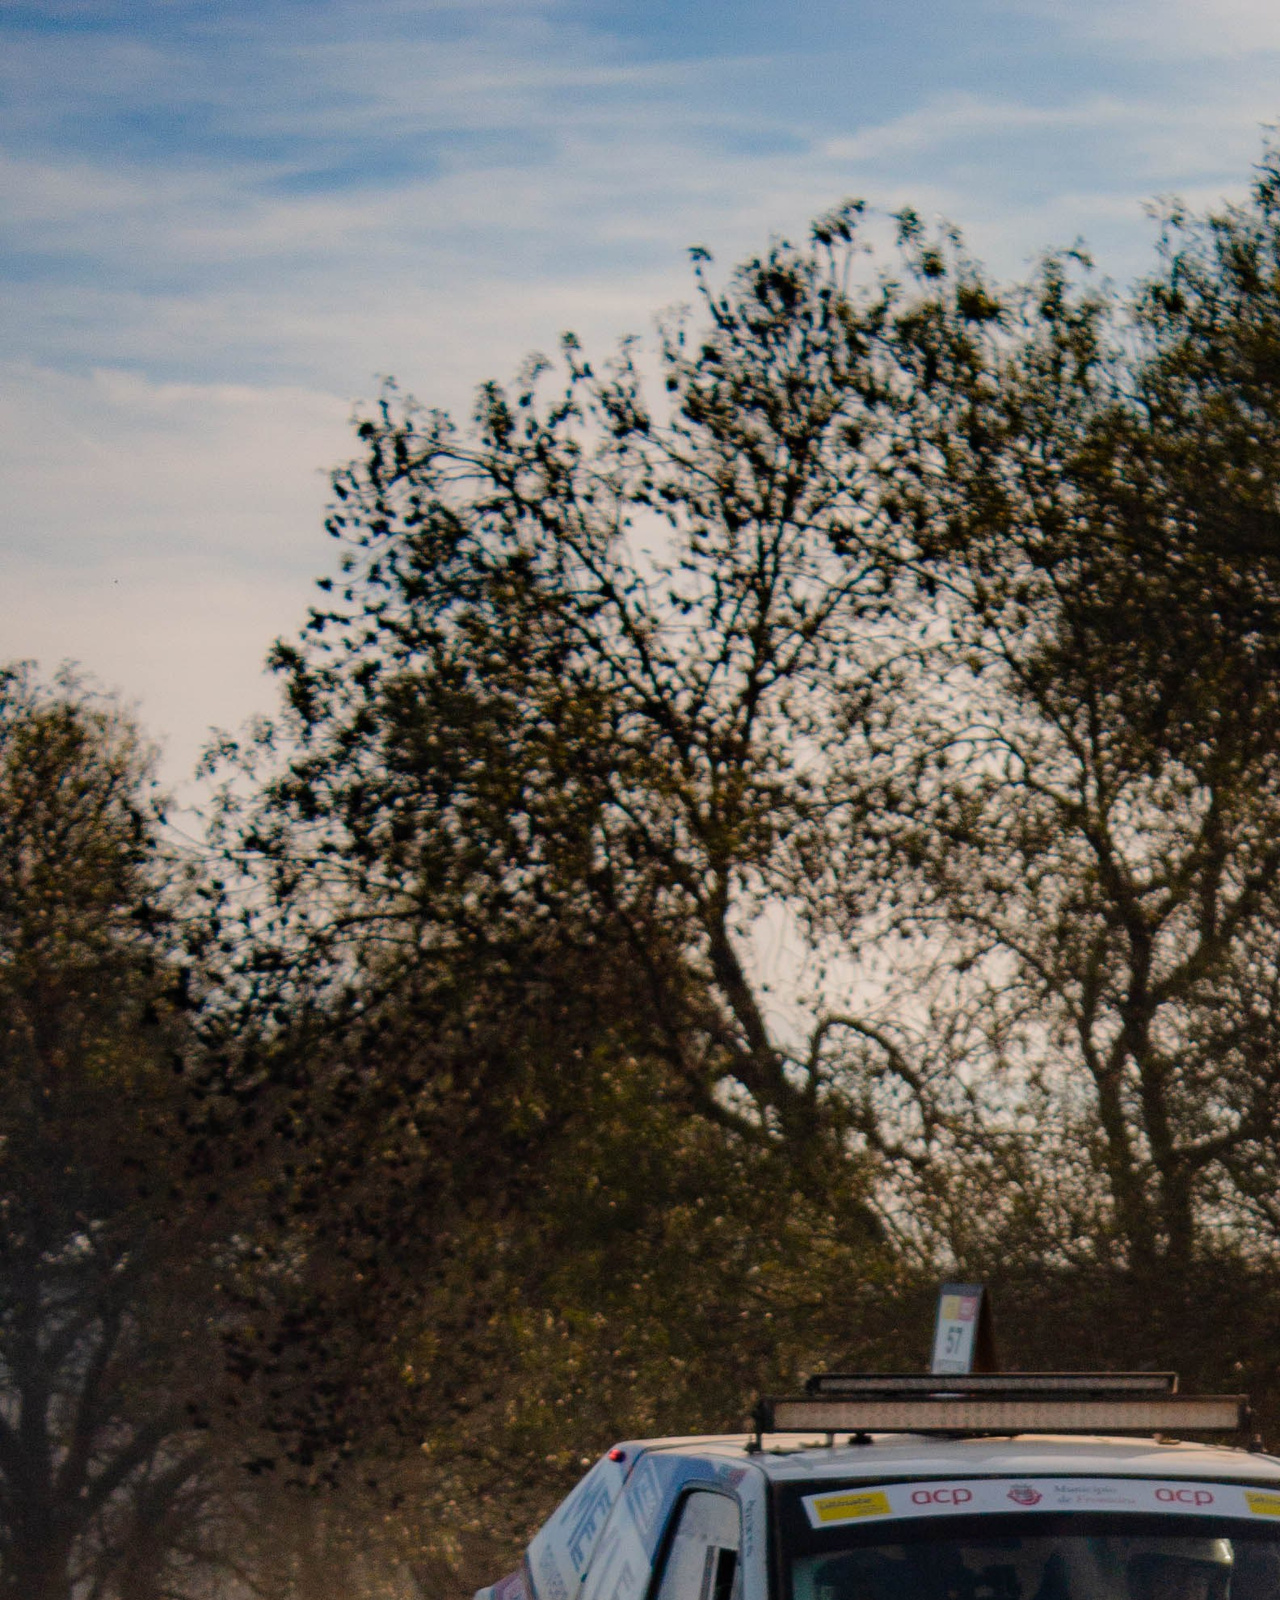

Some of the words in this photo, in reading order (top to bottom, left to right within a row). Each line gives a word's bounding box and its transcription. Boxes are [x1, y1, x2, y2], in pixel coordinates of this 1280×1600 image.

[946, 1327, 963, 1354] 57
[911, 1488, 972, 1506] acp
[1154, 1487, 1215, 1506] acp
